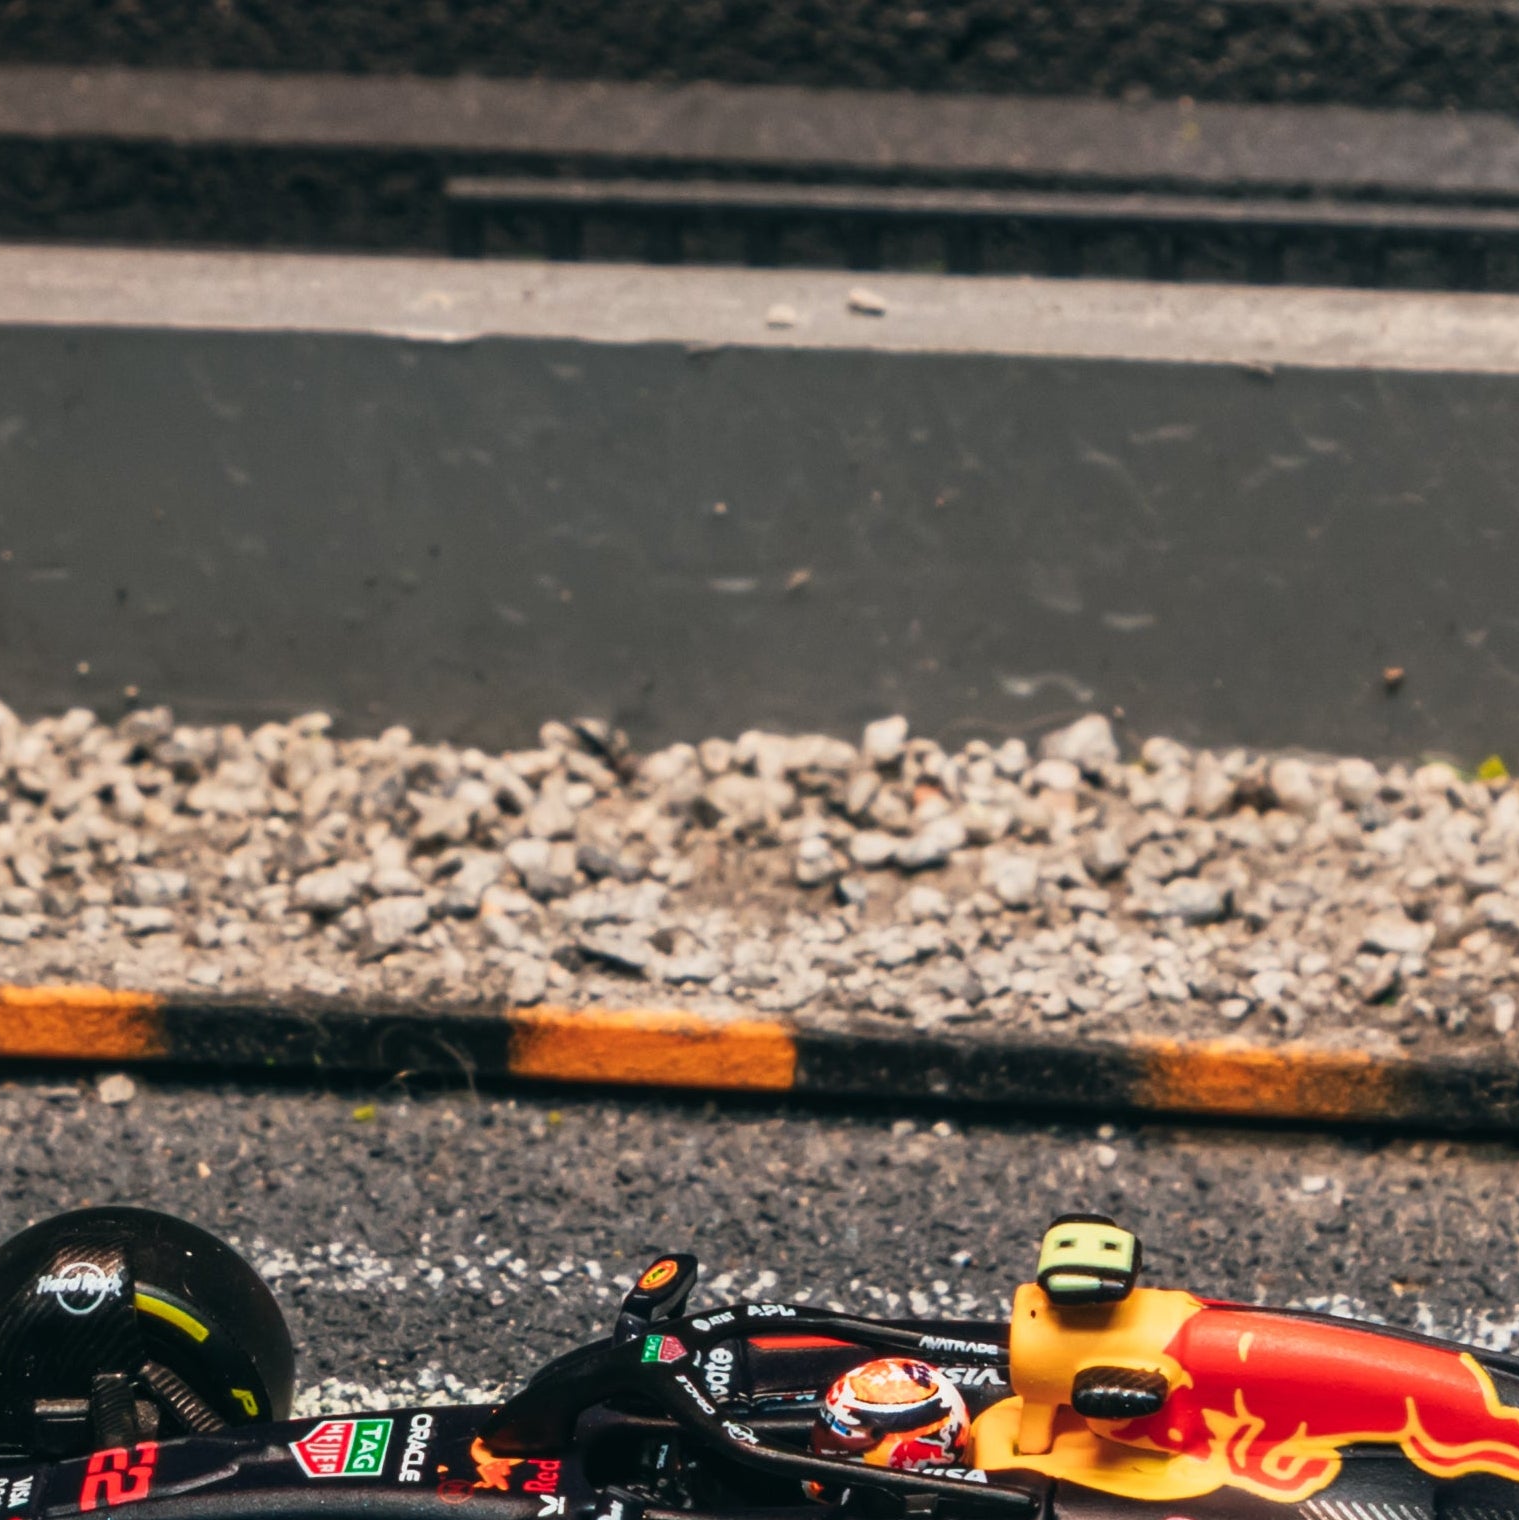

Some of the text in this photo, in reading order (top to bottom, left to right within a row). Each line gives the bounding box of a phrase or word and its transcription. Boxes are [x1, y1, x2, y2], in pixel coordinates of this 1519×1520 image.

[305, 1424, 345, 1473] HEUER
[352, 1424, 383, 1470] TAG
[398, 1413, 433, 1482] ORACLE
[524, 1458, 562, 1494] Red
